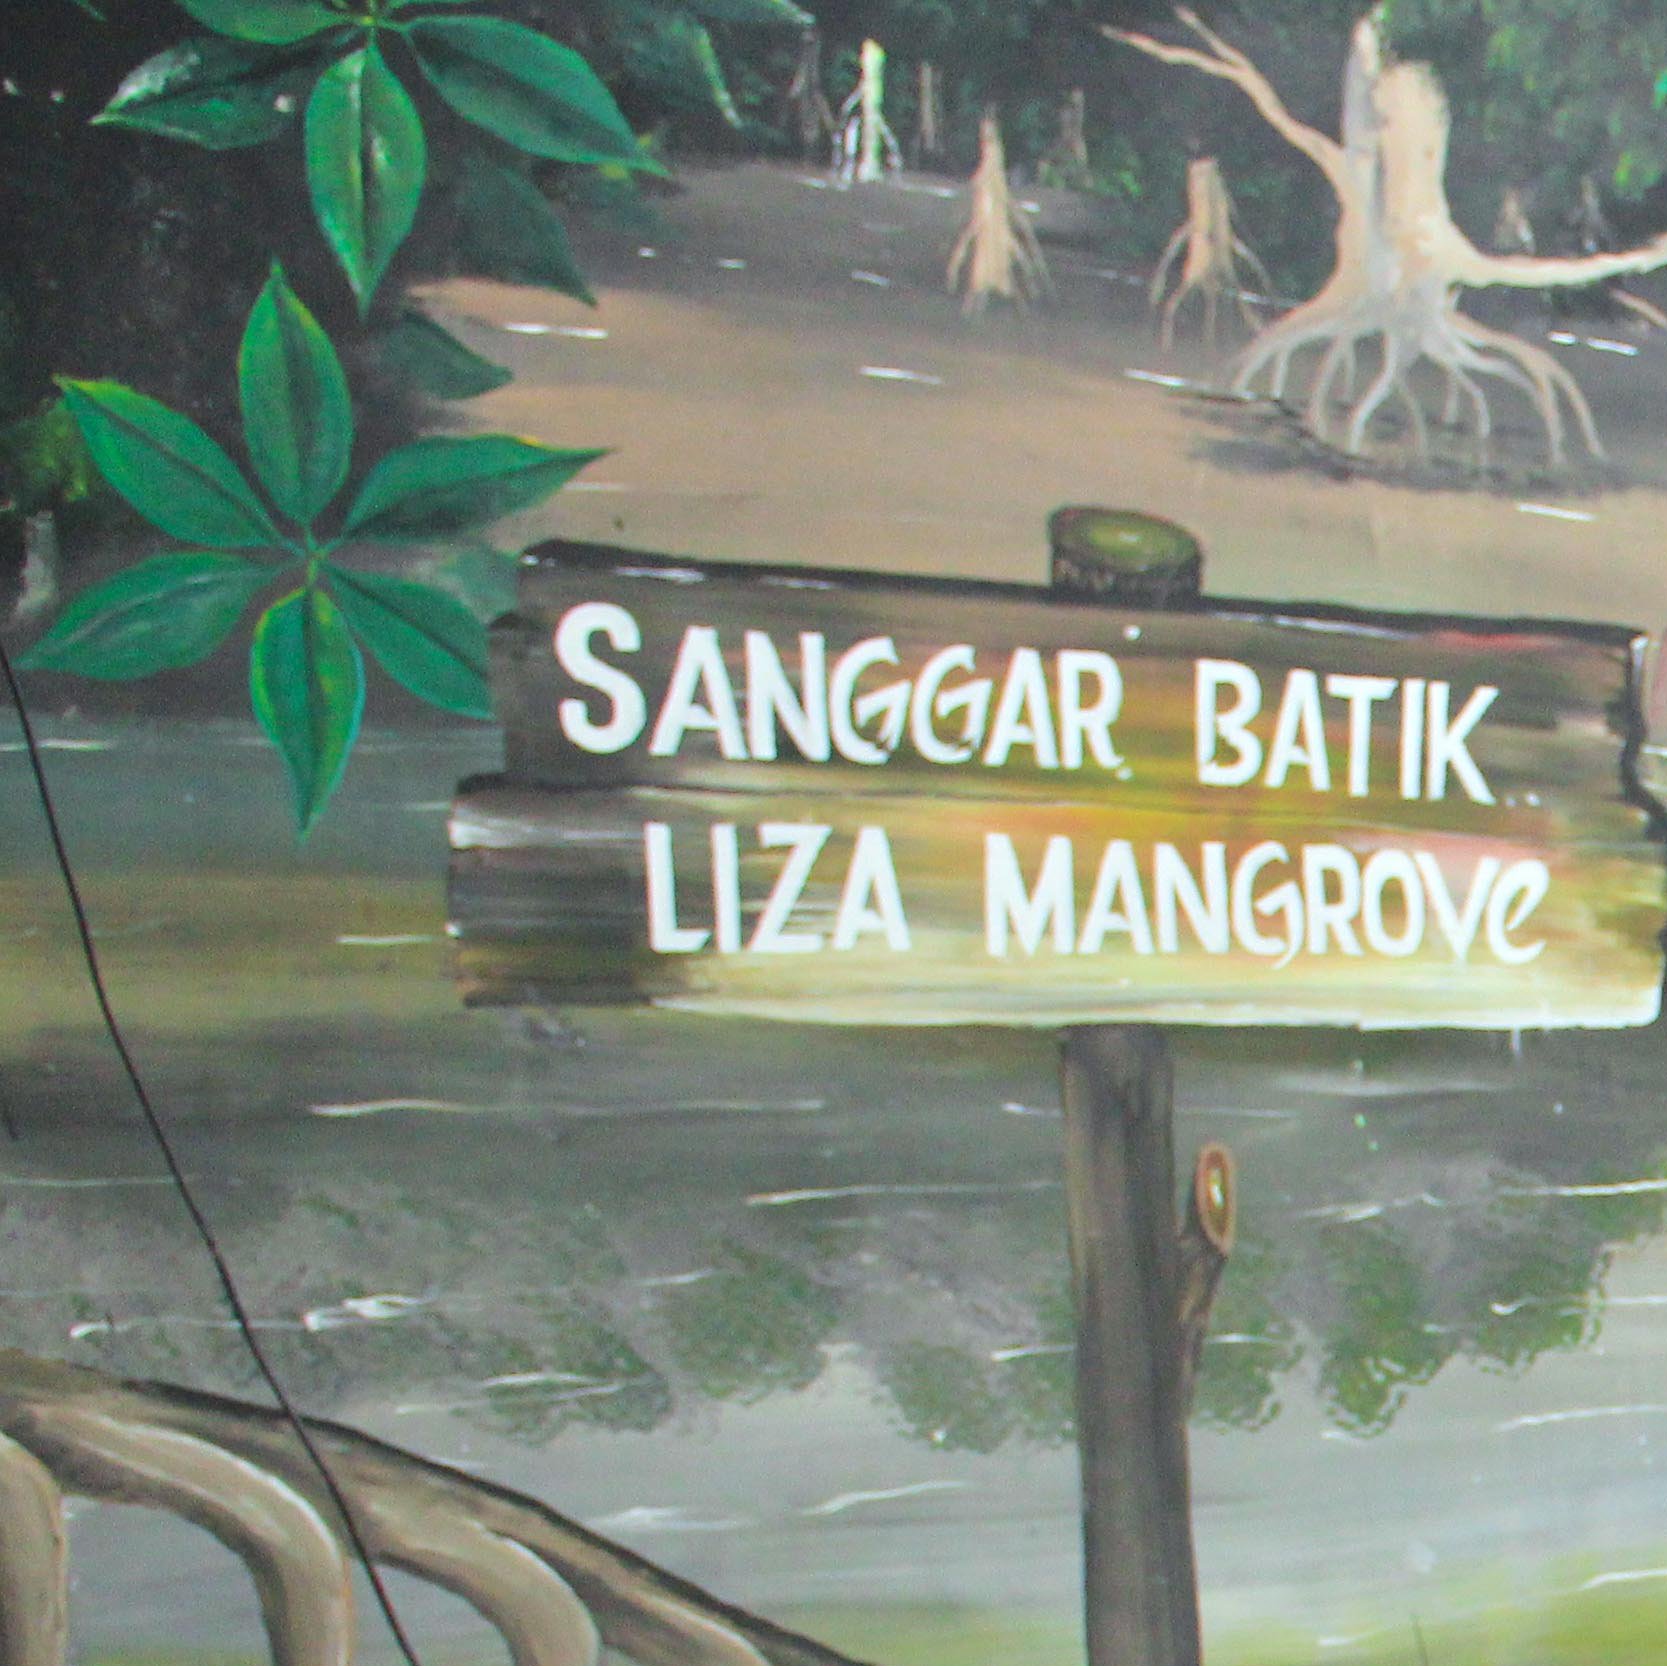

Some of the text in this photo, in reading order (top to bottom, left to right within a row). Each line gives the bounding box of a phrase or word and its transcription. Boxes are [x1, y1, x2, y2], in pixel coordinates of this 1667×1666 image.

[555, 601, 1499, 805] SANGGAR BATIK
[644, 821, 912, 957] LIZA
